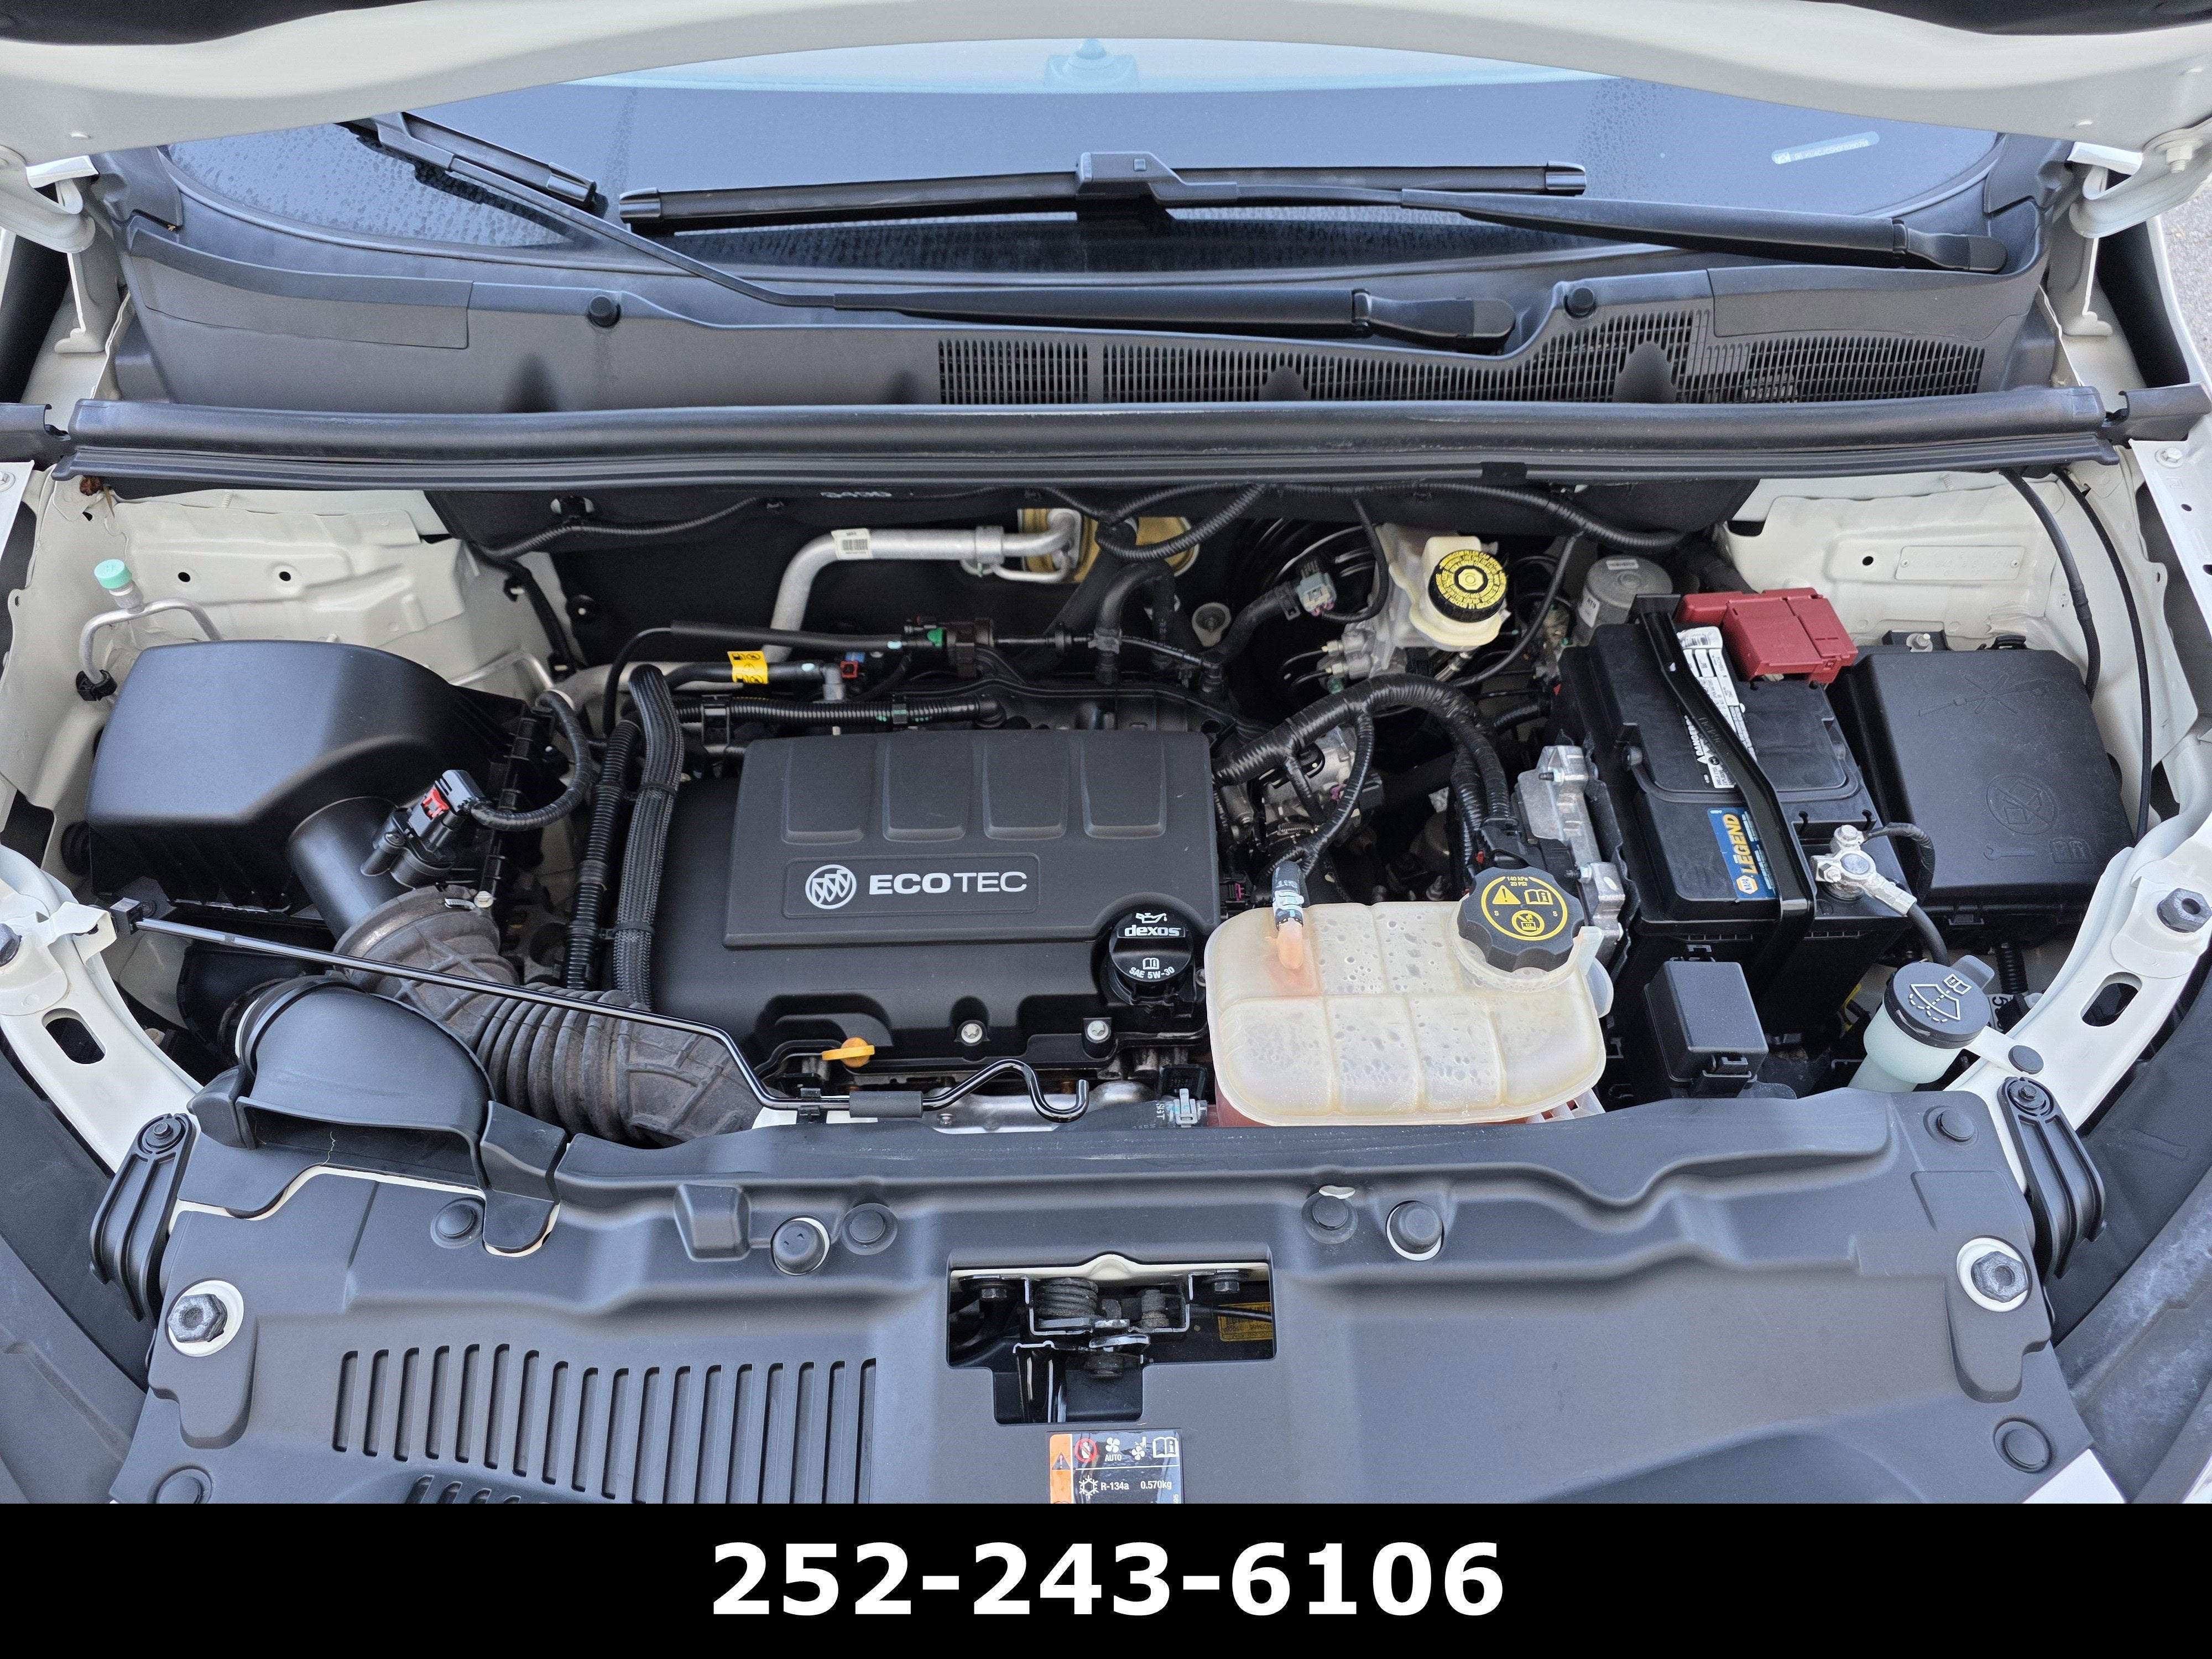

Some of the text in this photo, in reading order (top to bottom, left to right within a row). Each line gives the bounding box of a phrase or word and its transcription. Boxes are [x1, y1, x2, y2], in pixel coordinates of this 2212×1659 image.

[1722, 813, 1758, 874] LEGEND
[869, 871, 1027, 895] ECOTEC
[1741, 878, 1752, 890] NAPA
[1124, 925, 1182, 937] dexos
[1129, 966, 1175, 979] SAE 5W-30
[1104, 1453, 1122, 1462] AUTO
[1100, 1480, 1172, 1491] R-134a 0.570kg
